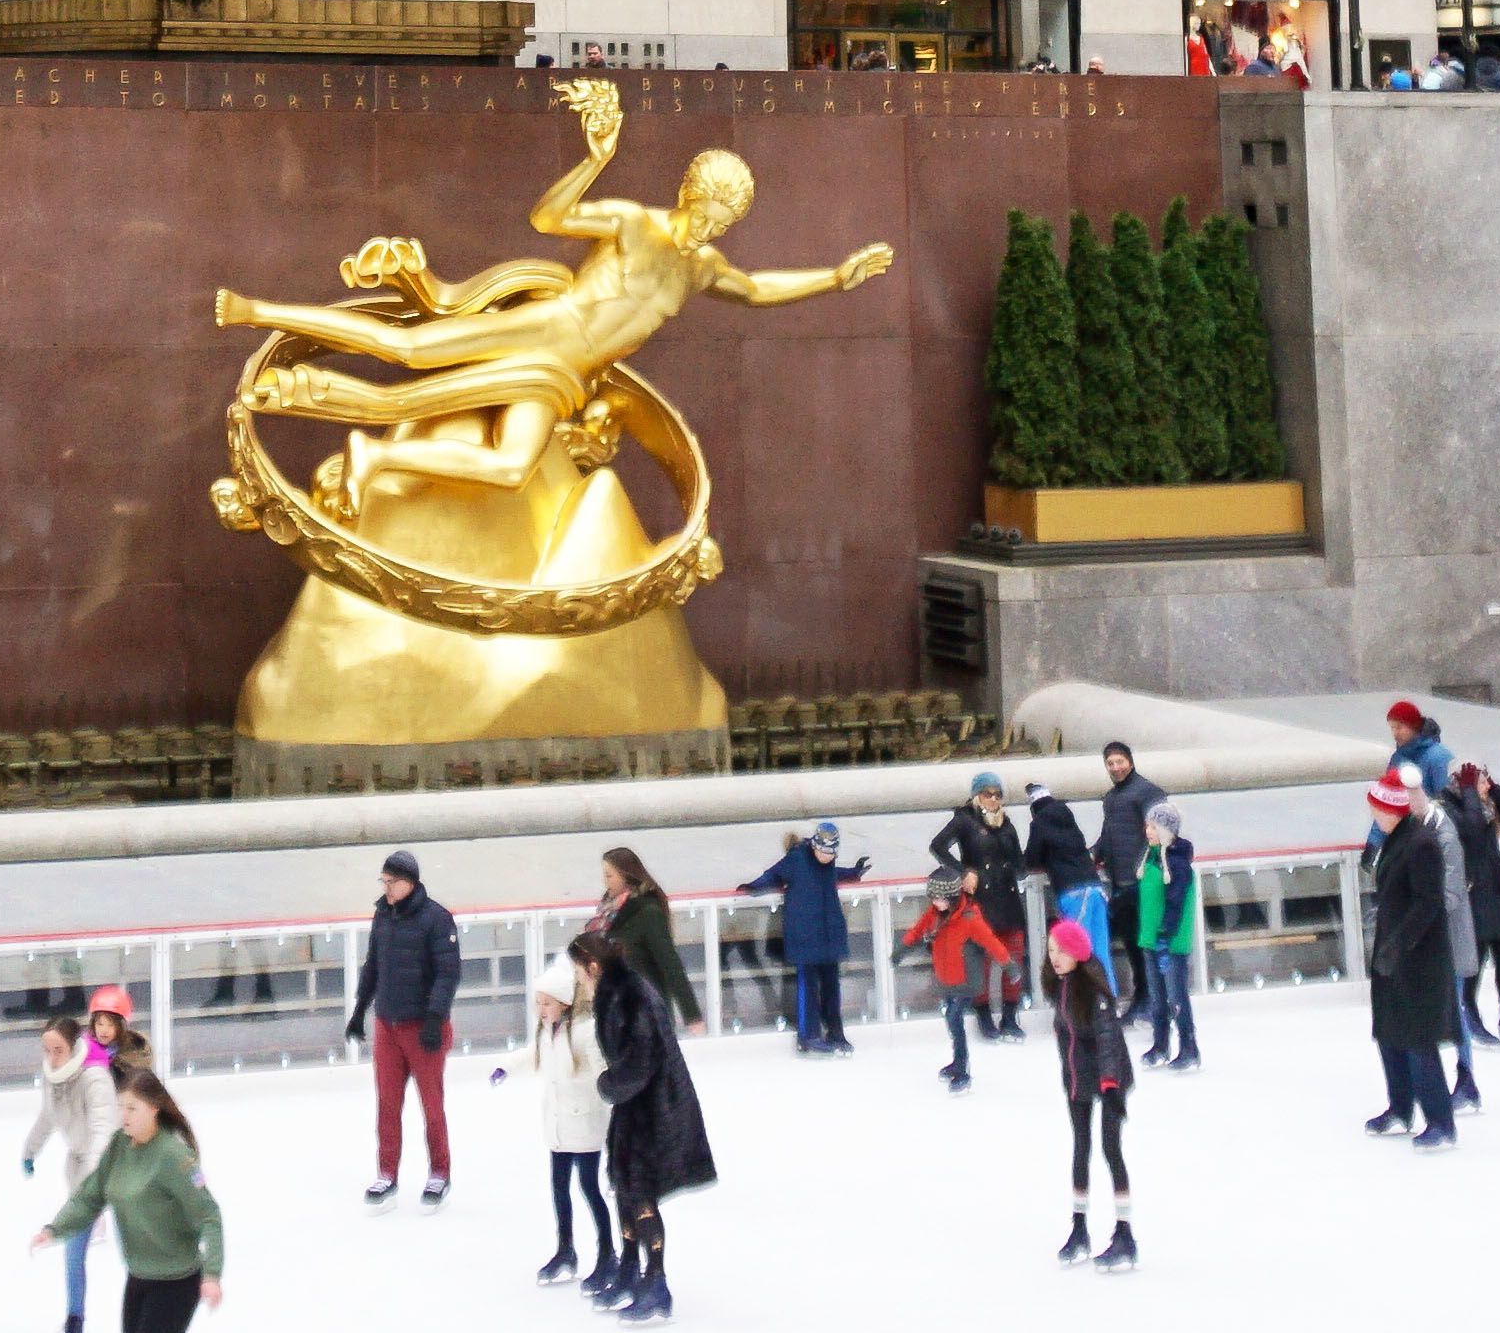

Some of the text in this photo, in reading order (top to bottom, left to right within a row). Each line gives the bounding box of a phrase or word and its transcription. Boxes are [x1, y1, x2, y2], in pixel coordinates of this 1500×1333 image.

[225, 72, 266, 86] IN
[322, 72, 462, 89] EVERY
[883, 80, 951, 94] THE
[1002, 81, 1096, 96] FIRE
[120, 90, 165, 106] TO
[220, 93, 430, 110] MORTALS
[485, 97, 496, 110] A
[548, 97, 682, 113] MNS
[734, 99, 775, 113] TO
[824, 99, 981, 114] MIGHTY
[1032, 101, 1128, 117] ENDS
